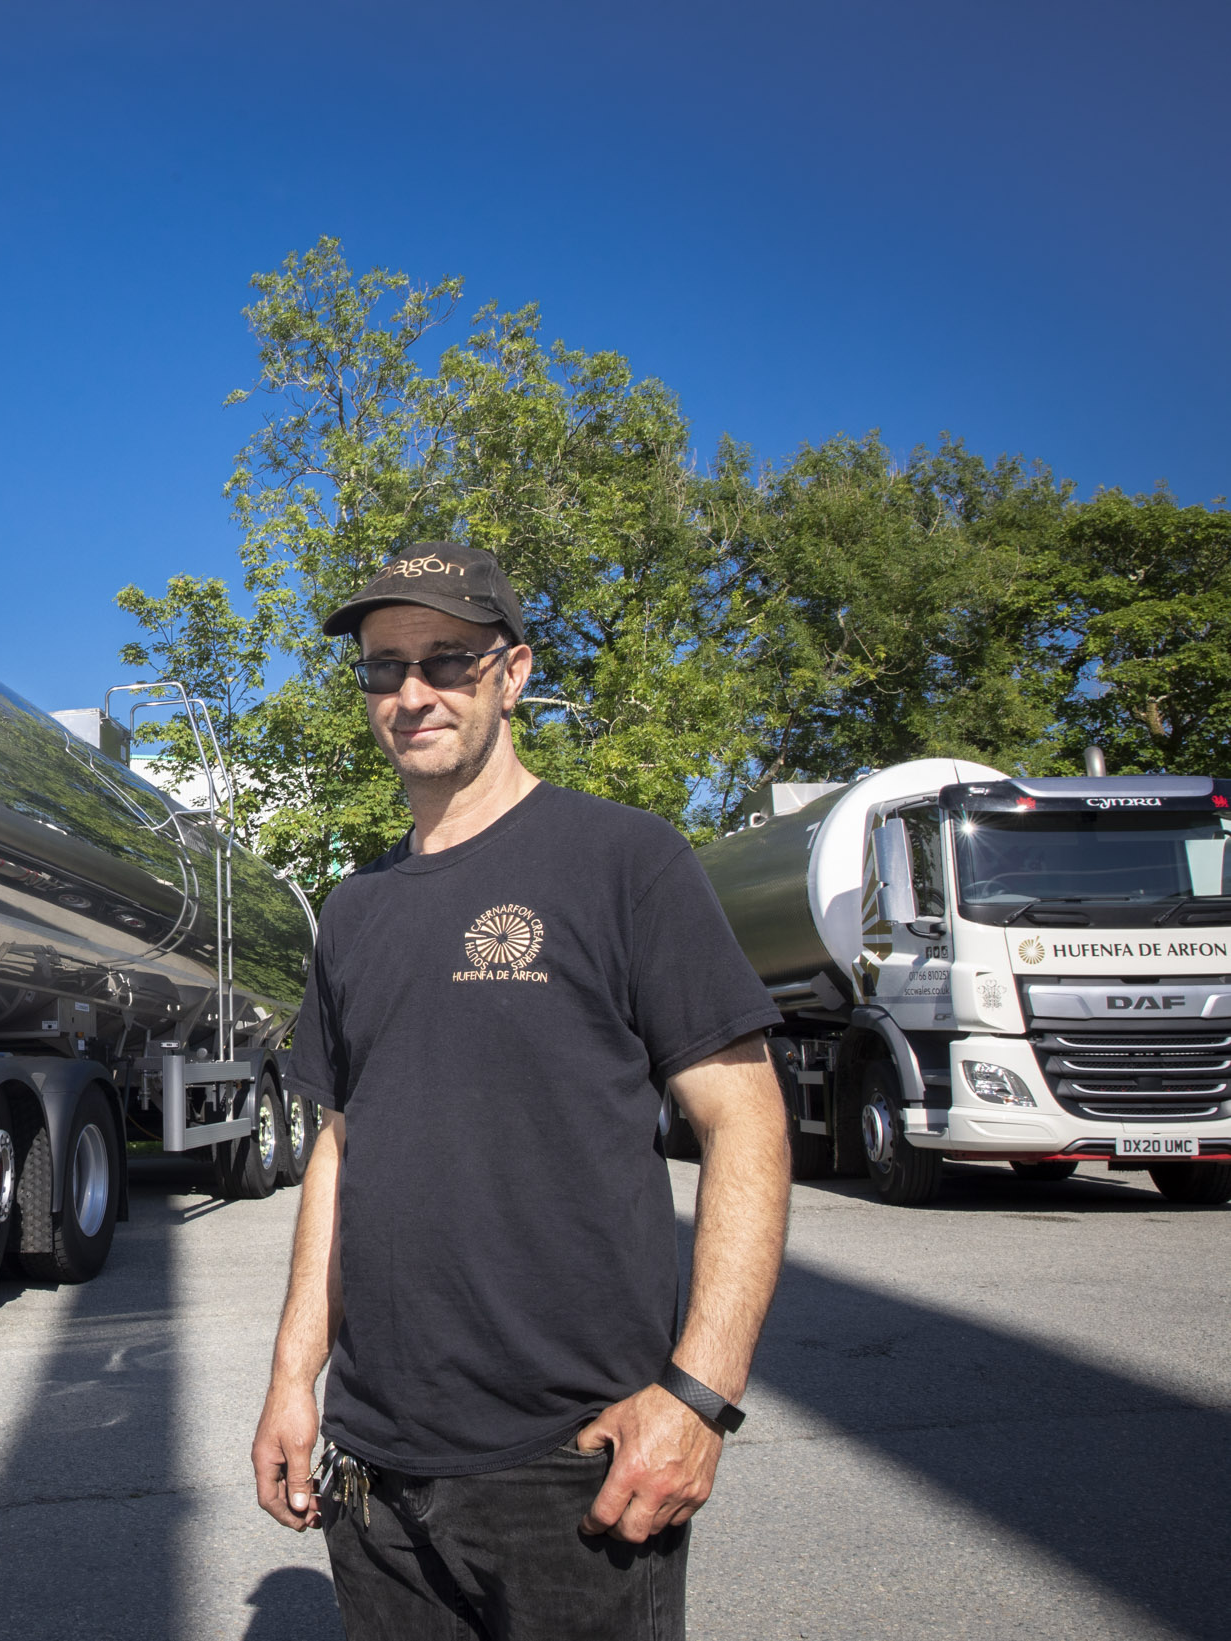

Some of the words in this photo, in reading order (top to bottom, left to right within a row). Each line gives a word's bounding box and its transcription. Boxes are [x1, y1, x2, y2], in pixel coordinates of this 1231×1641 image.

[471, 903, 535, 932] CAERNARFON
[510, 918, 544, 971] CREAMERIES
[1053, 943, 1134, 958] HUFENFA
[1138, 943, 1162, 957] DE
[1166, 942, 1228, 957] ARFON
[465, 941, 489, 970] SOUTH
[452, 970, 494, 982] HUFENFA
[496, 970, 510, 980] DE
[511, 970, 548, 983] ARFON
[908, 971, 927, 982] 01766
[927, 970, 950, 981] 810251
[904, 985, 950, 996] sccwales.co.uk
[1106, 995, 1186, 1010] DAF
[1123, 1139, 1161, 1153] DX20
[1164, 1139, 1193, 1153] UMC
